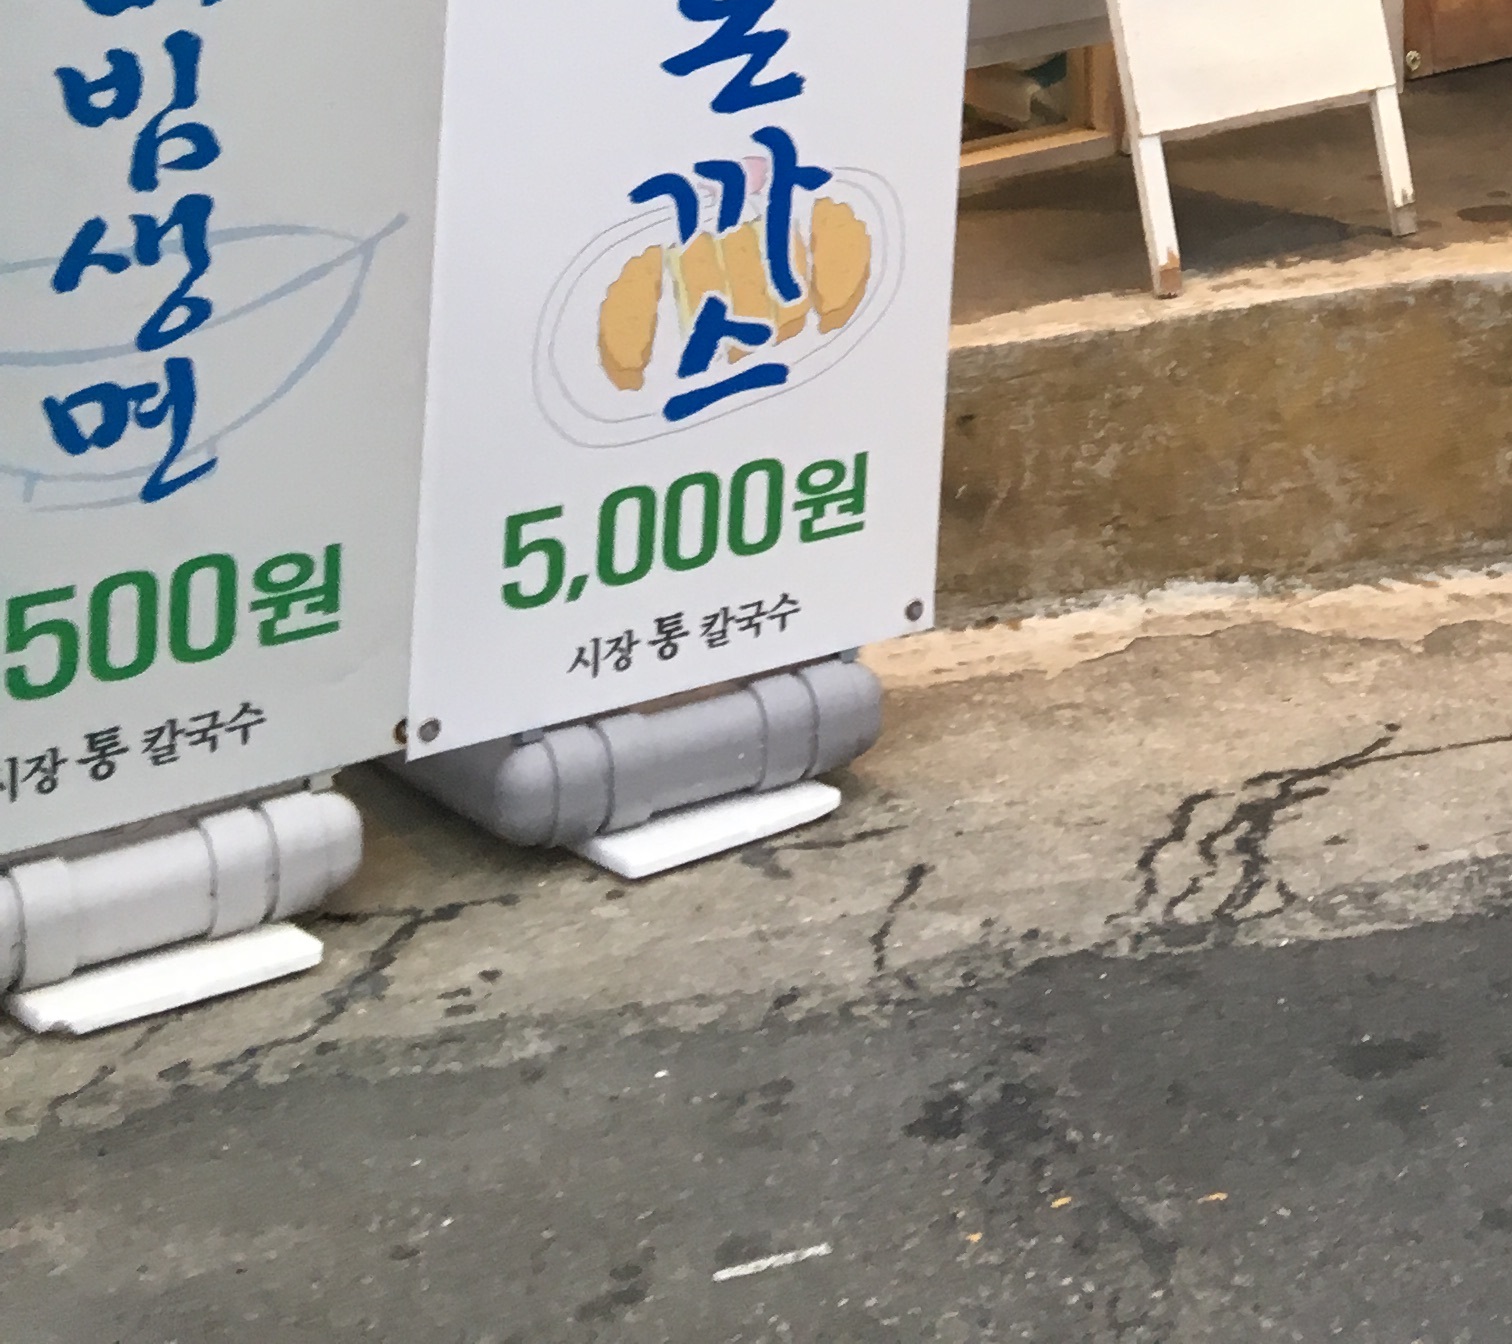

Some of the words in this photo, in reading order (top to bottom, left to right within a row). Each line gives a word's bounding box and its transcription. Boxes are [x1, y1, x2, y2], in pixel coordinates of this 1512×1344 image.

[502, 451, 870, 610] 5,000원
[4, 543, 343, 702] 500원
[567, 629, 641, 679] 시장
[647, 611, 690, 661] 통
[700, 592, 802, 650] 칼국수
[75, 724, 130, 782] 통
[141, 701, 267, 767] 칼국수
